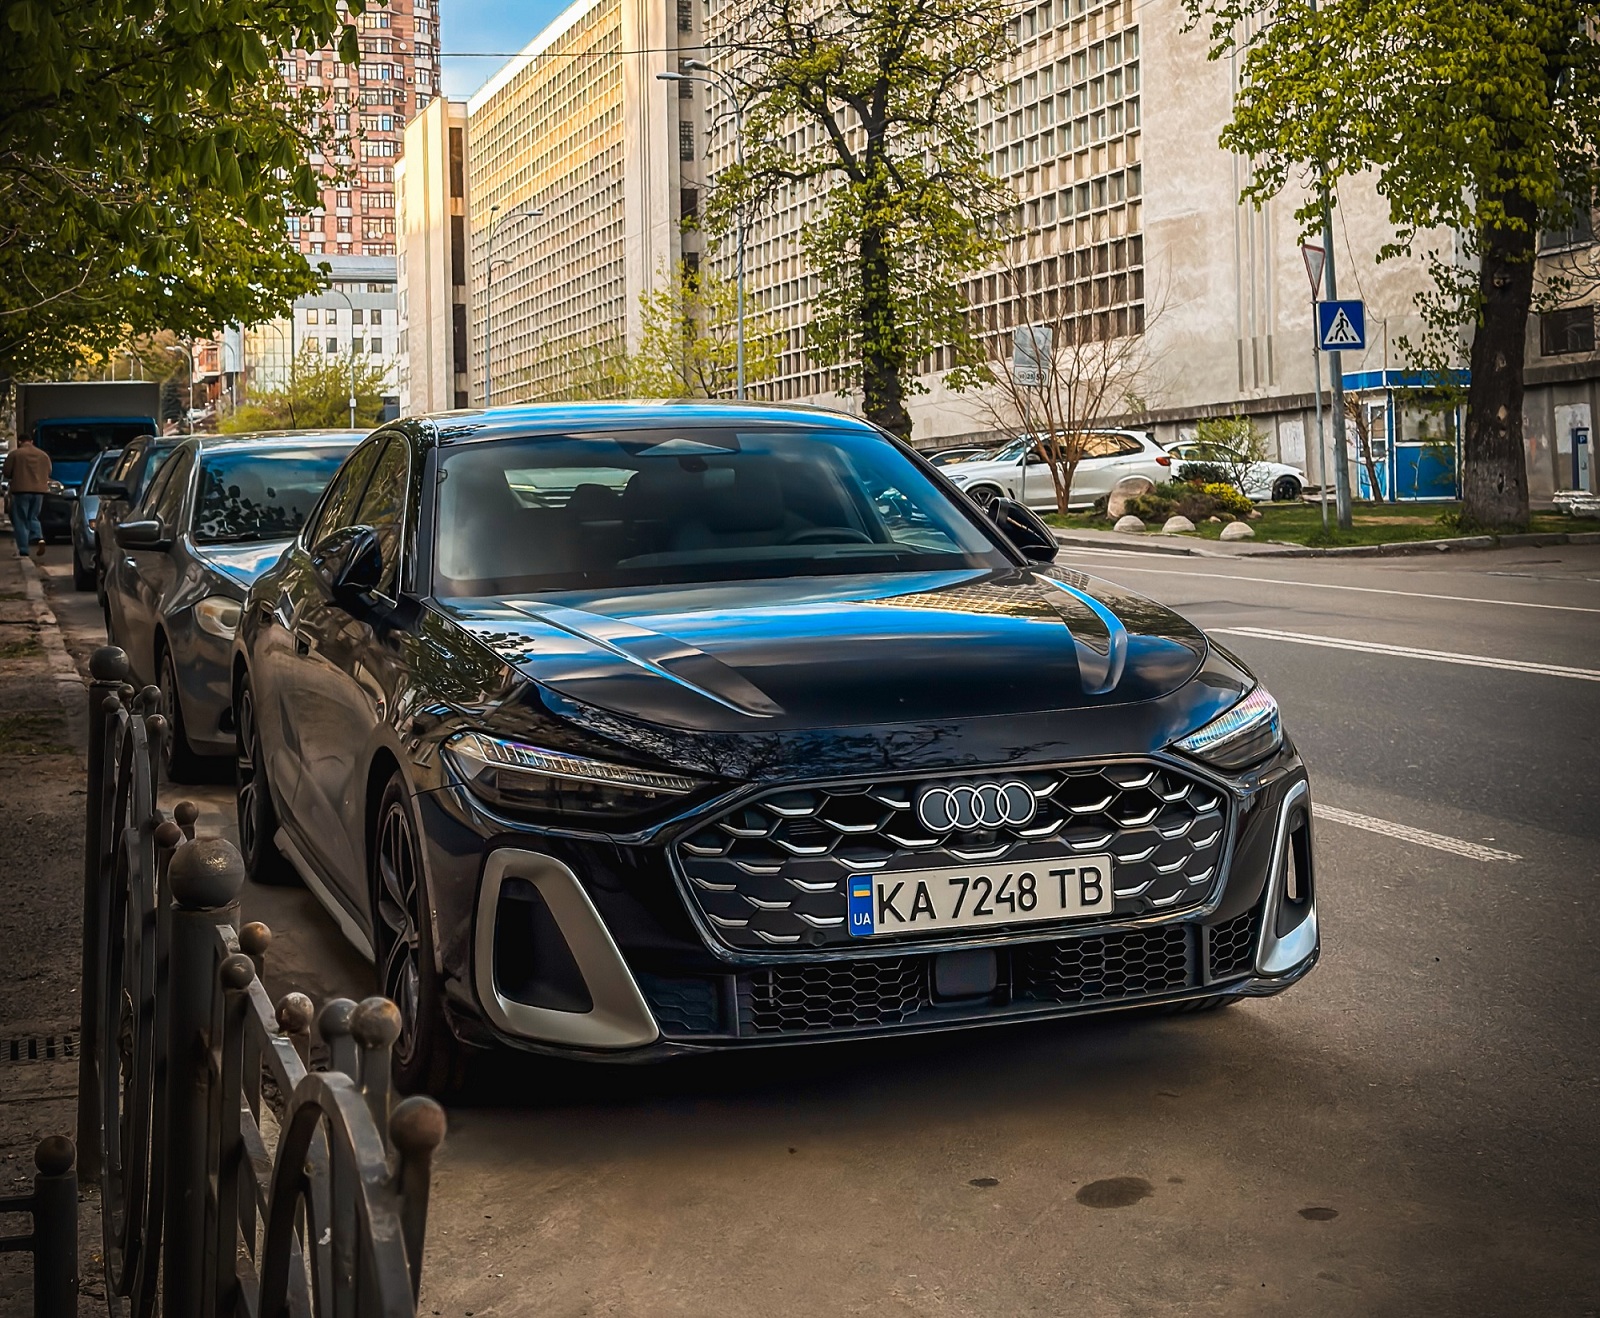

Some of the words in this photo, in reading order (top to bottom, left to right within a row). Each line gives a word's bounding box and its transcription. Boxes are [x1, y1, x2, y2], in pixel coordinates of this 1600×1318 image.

[877, 881, 937, 925] KA
[948, 872, 1038, 919] 7248
[1049, 866, 1104, 909] TB
[853, 912, 872, 926] UA
